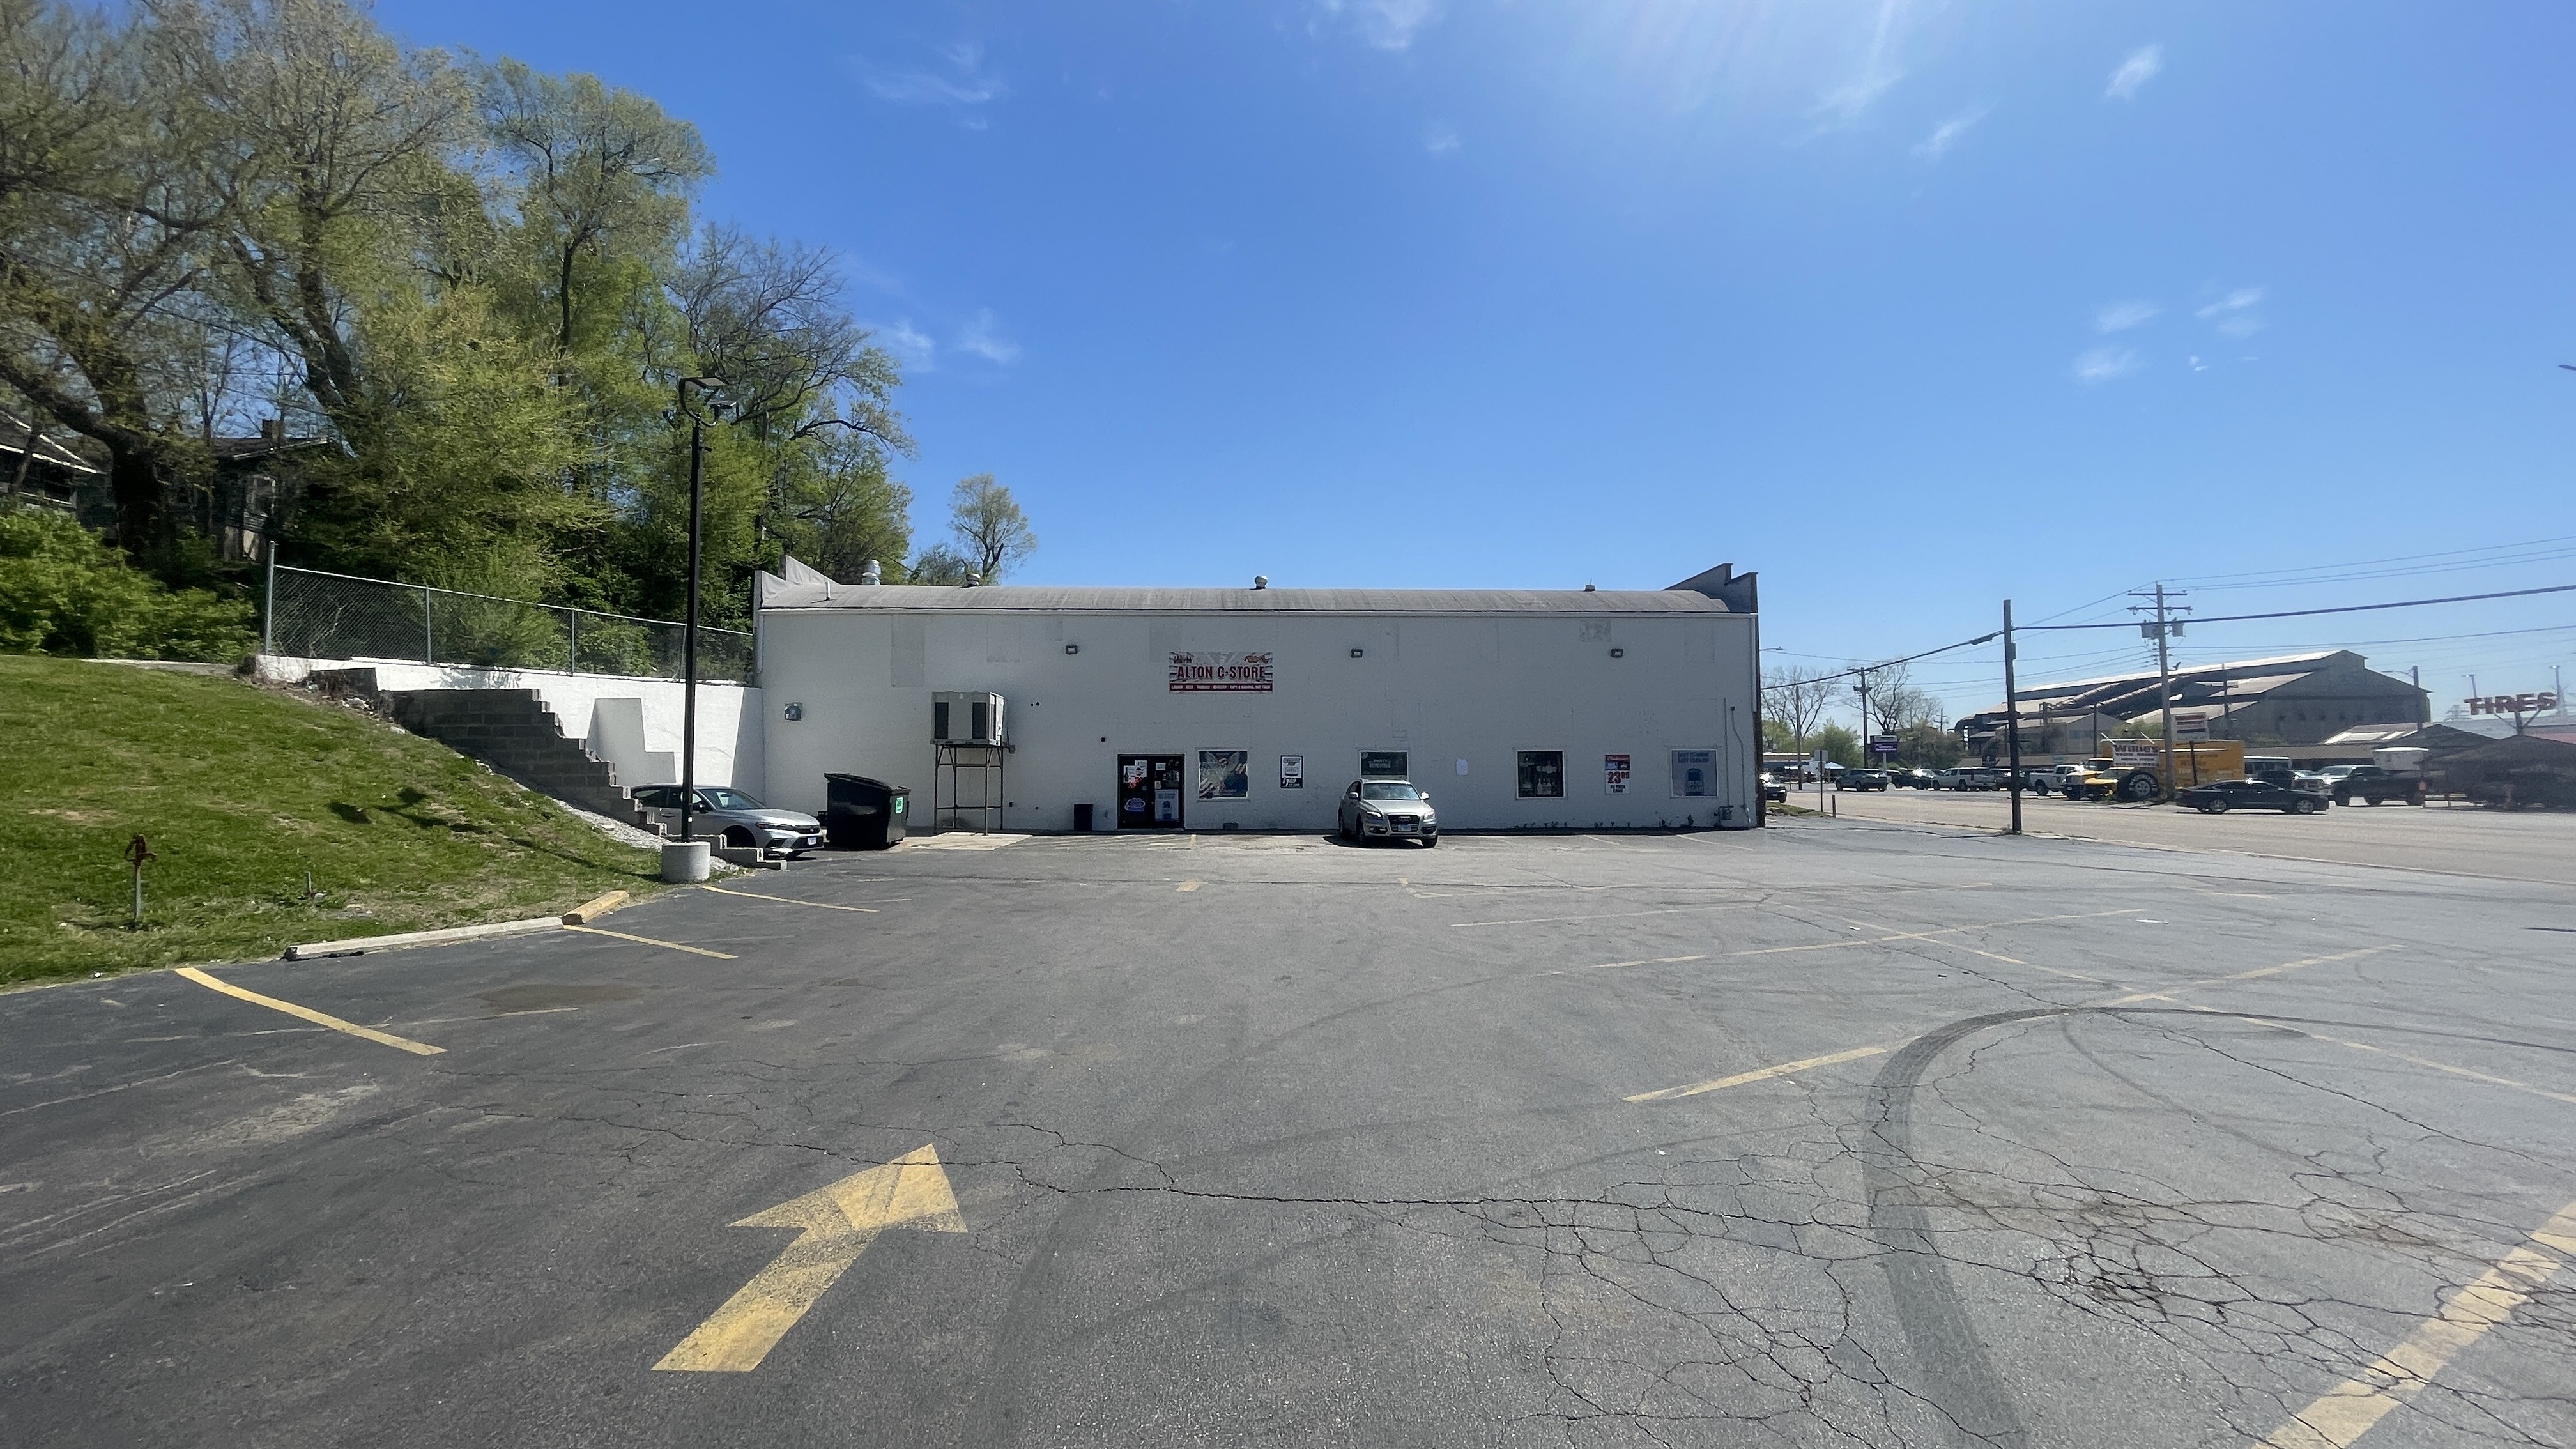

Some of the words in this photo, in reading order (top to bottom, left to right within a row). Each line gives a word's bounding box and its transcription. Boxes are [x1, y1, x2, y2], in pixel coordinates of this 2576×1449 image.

[1177, 666, 1213, 678] ALTON
[1217, 666, 1266, 678] C-STORE
[2463, 692, 2556, 715] TIRES
